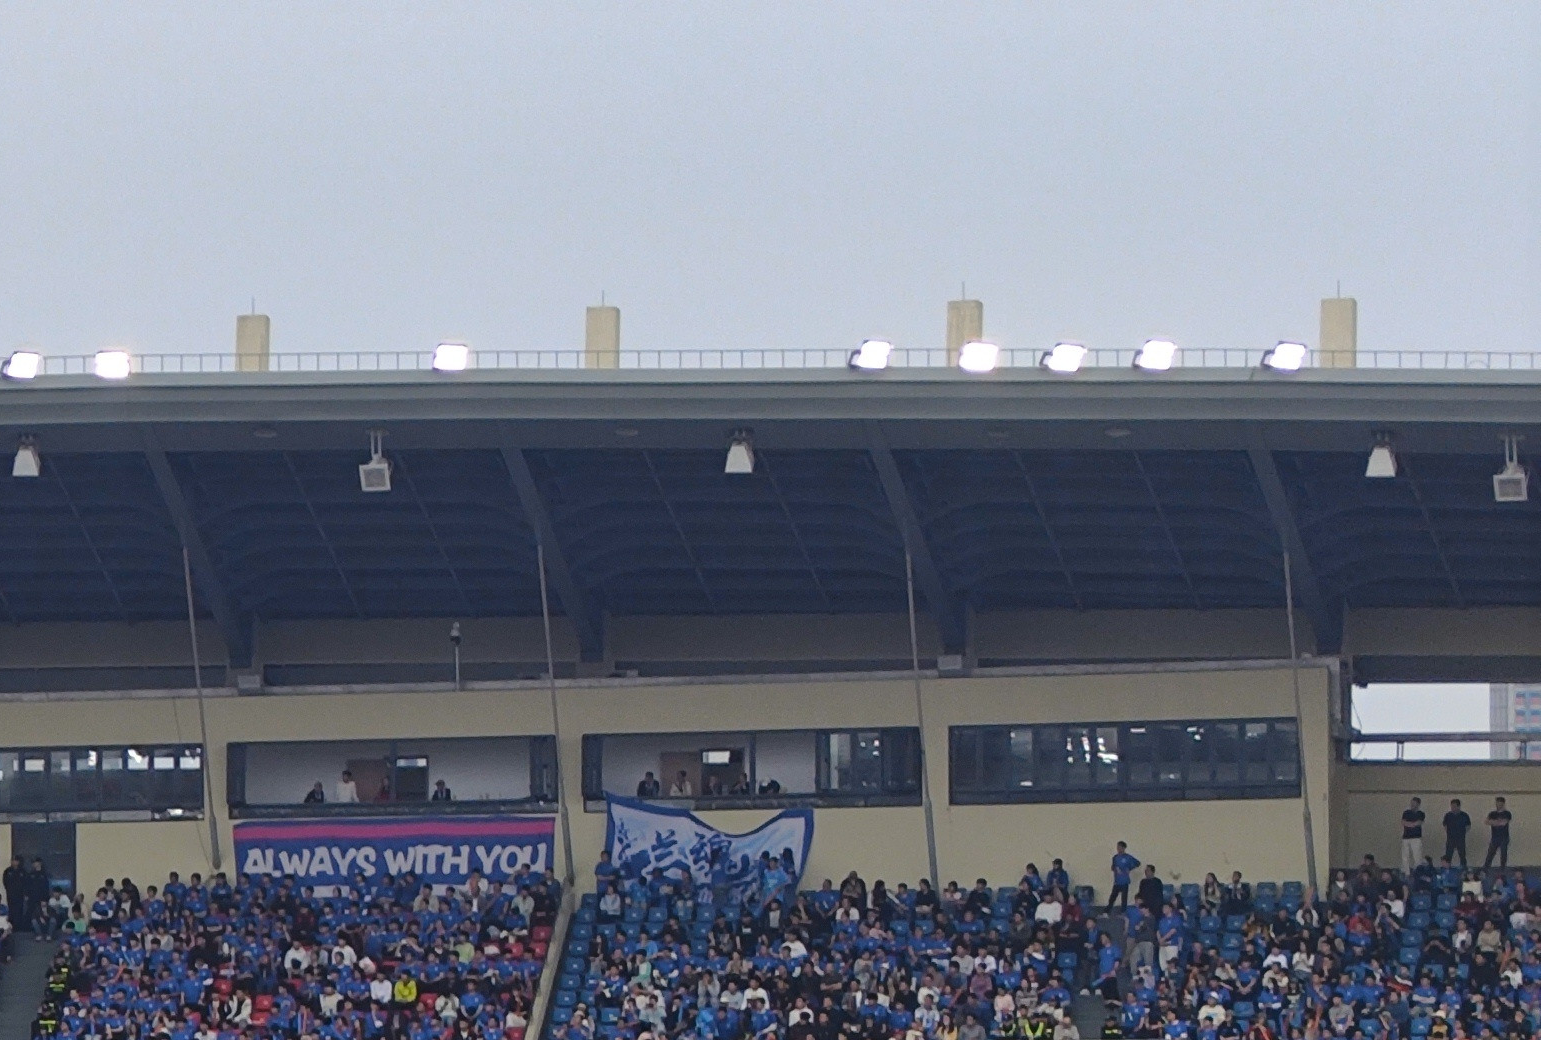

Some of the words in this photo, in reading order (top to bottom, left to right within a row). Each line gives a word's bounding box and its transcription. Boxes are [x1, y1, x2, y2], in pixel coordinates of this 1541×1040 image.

[243, 845, 377, 878] ALWAYS
[383, 843, 470, 876] WITH
[475, 841, 547, 876] YOU
